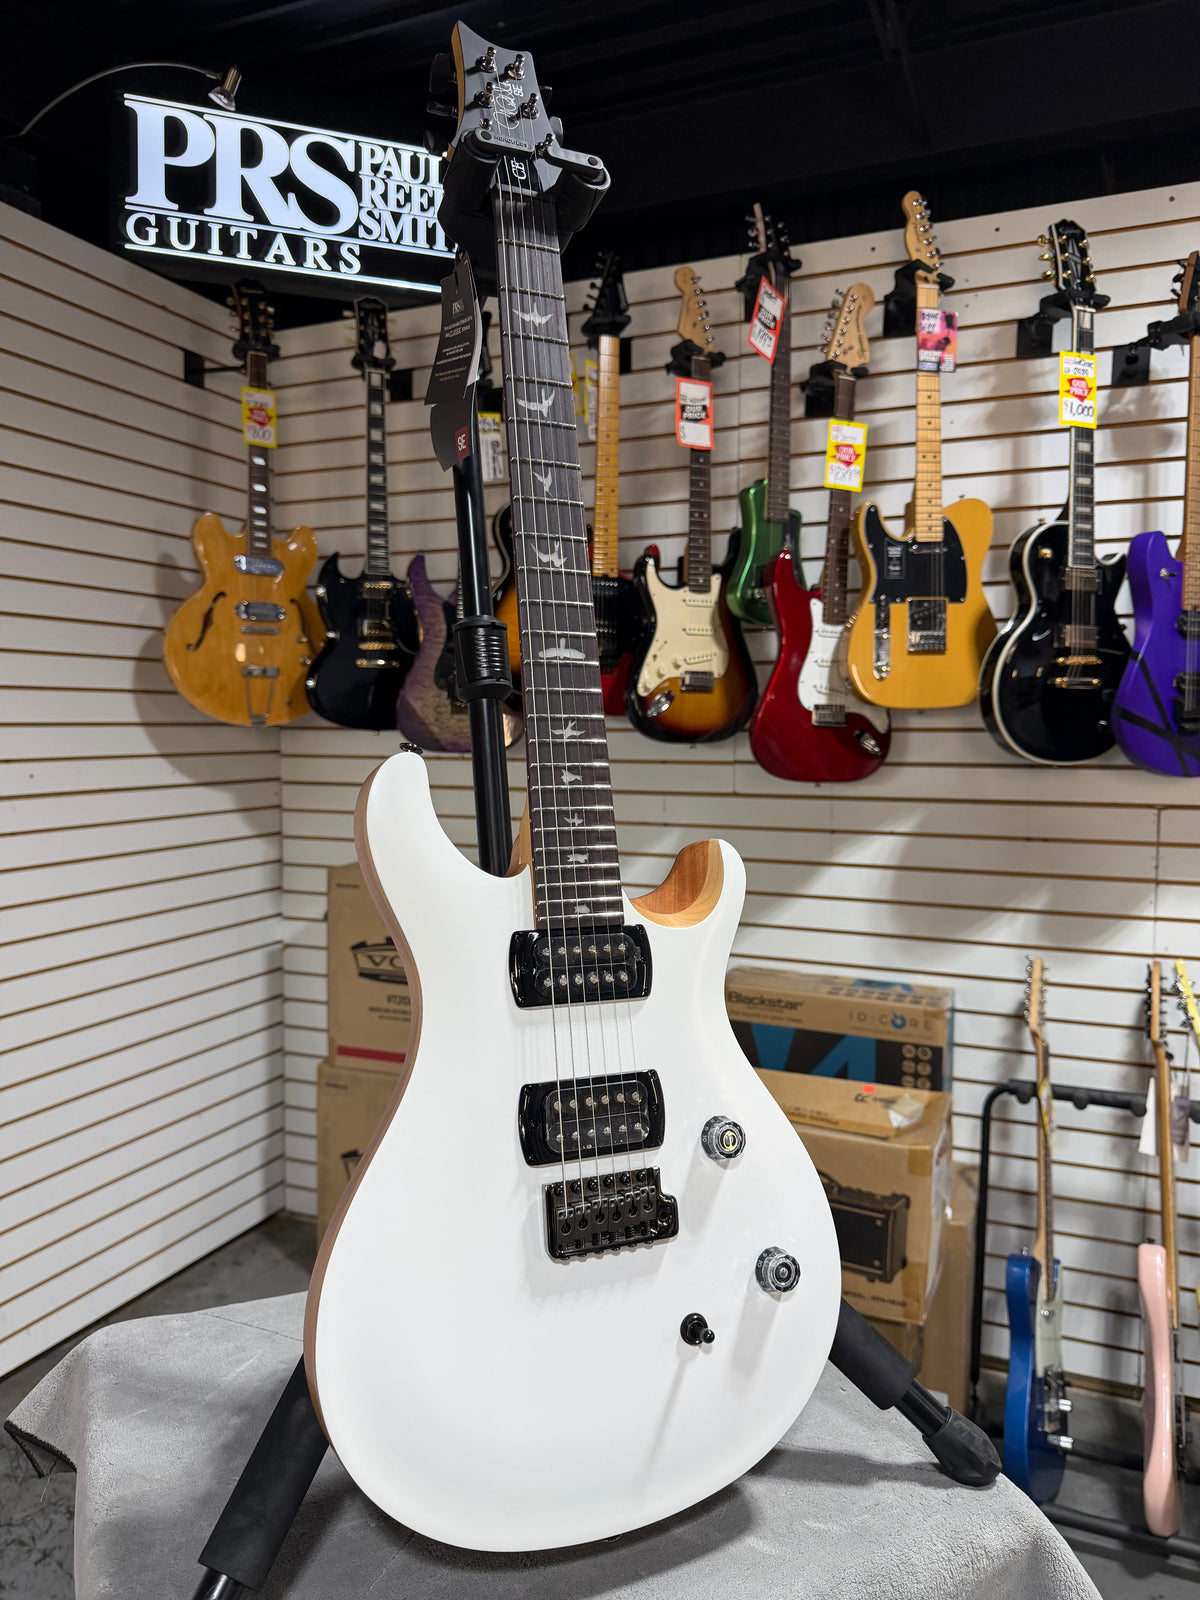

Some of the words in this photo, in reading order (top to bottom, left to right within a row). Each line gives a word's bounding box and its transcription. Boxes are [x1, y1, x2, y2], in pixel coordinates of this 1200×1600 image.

[124, 100, 359, 234] PRS
[125, 212, 360, 275] GUITARS
[359, 207, 458, 252] SMIT
[458, 434, 467, 451] SE
